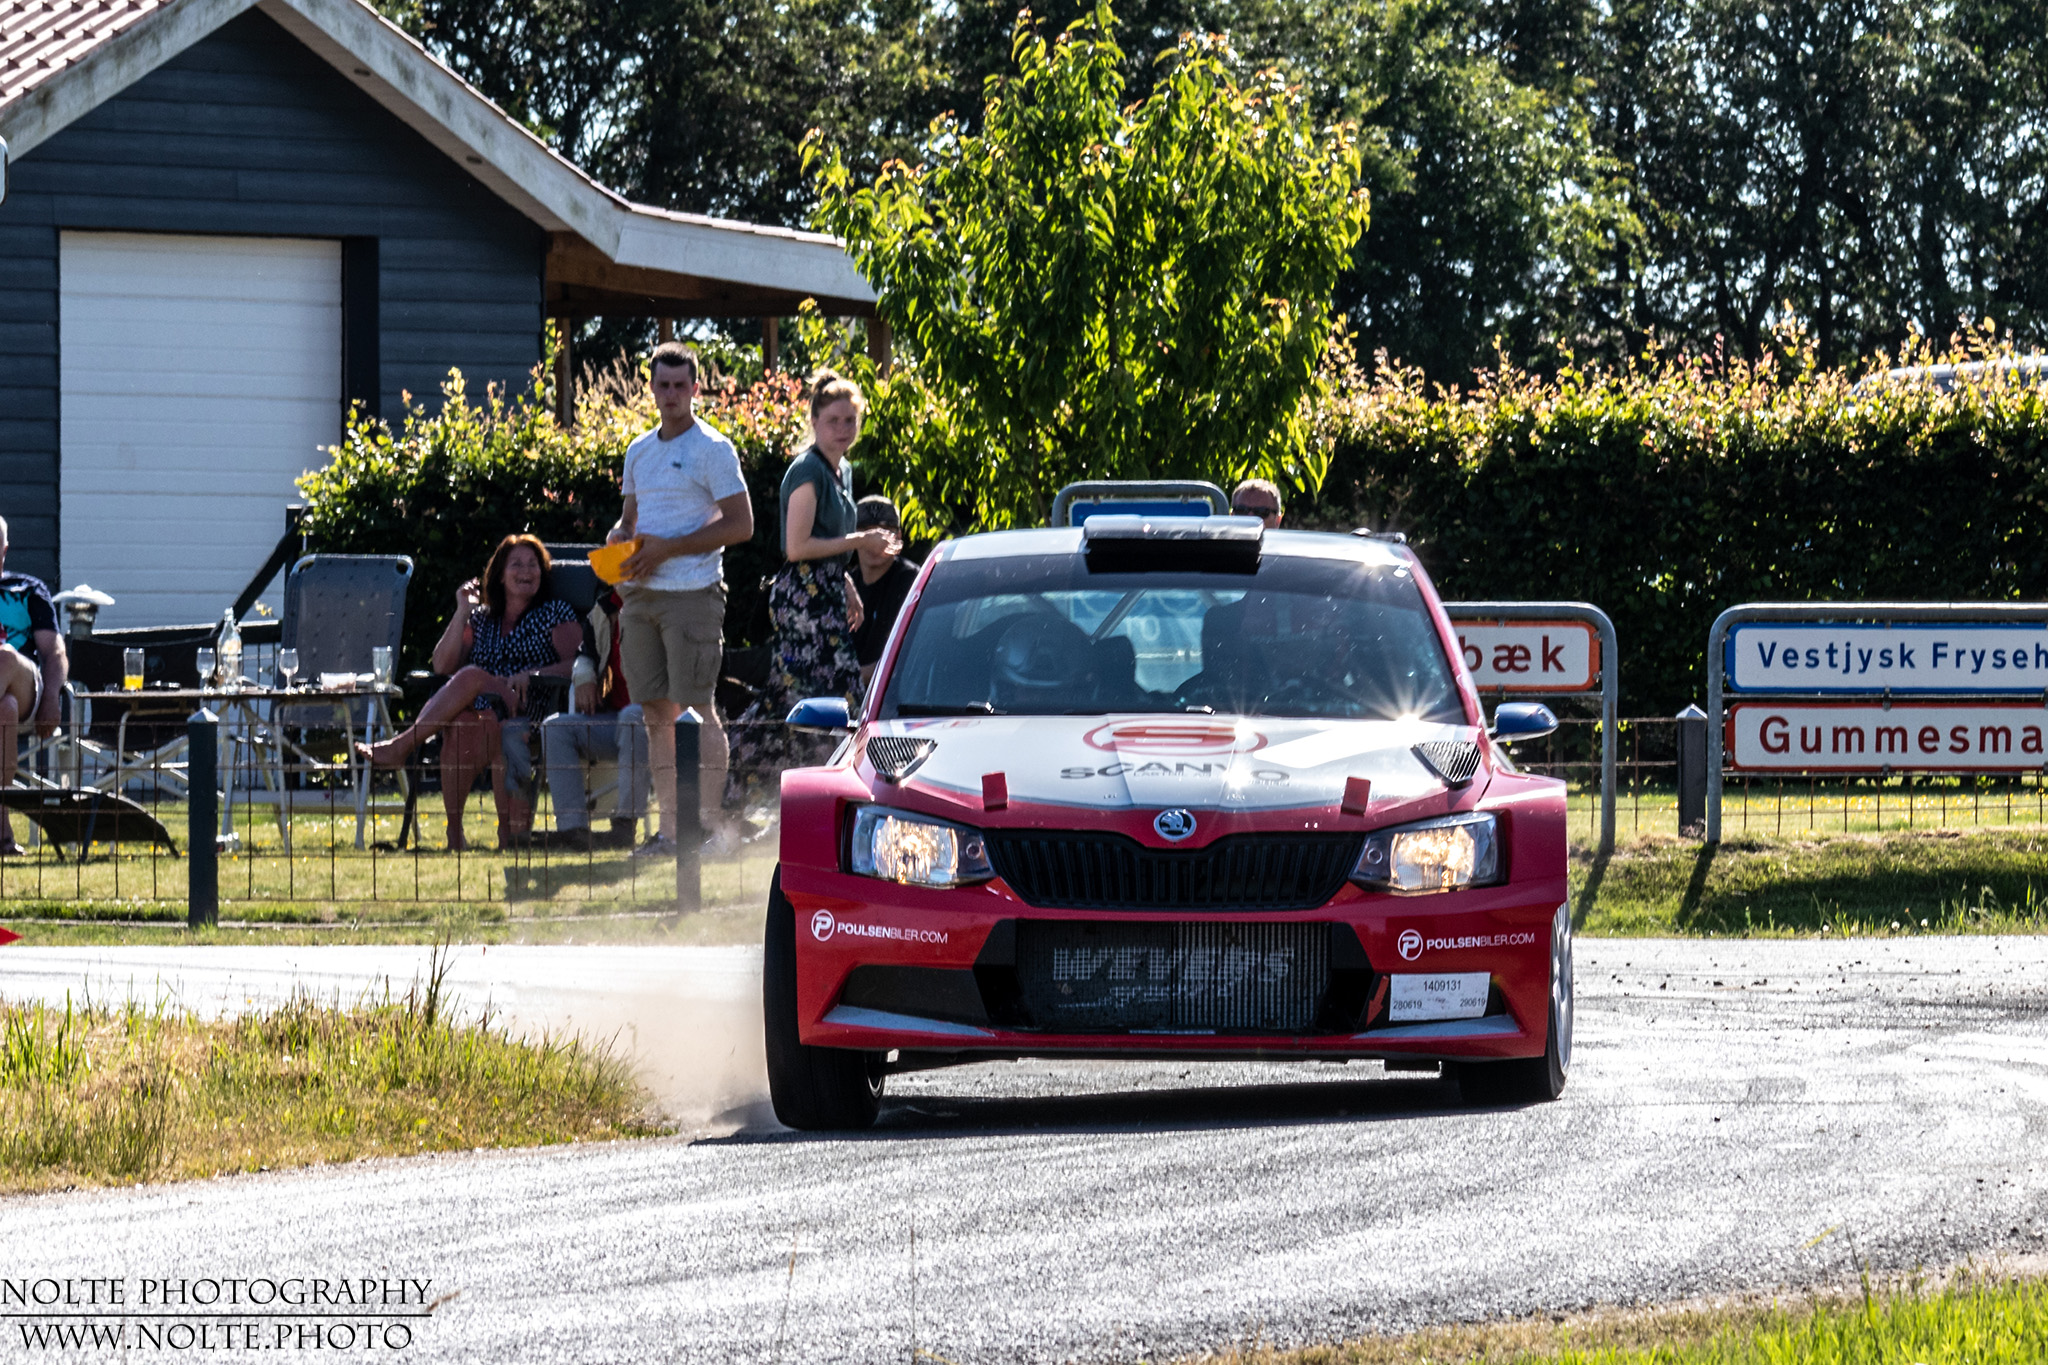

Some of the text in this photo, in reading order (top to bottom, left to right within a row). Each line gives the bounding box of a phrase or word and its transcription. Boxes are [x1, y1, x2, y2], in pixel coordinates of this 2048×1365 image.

[1757, 641, 2048, 674] Vestjysk Fryseh
[1758, 715, 2044, 754] Gummesma
[837, 922, 948, 944] POULSENBILER.COM
[1426, 932, 1535, 950] POULSENBILER.COM
[1423, 979, 1462, 992] 1409131
[1393, 1000, 1422, 1010] 280619
[1459, 998, 1486, 1008] 290619
